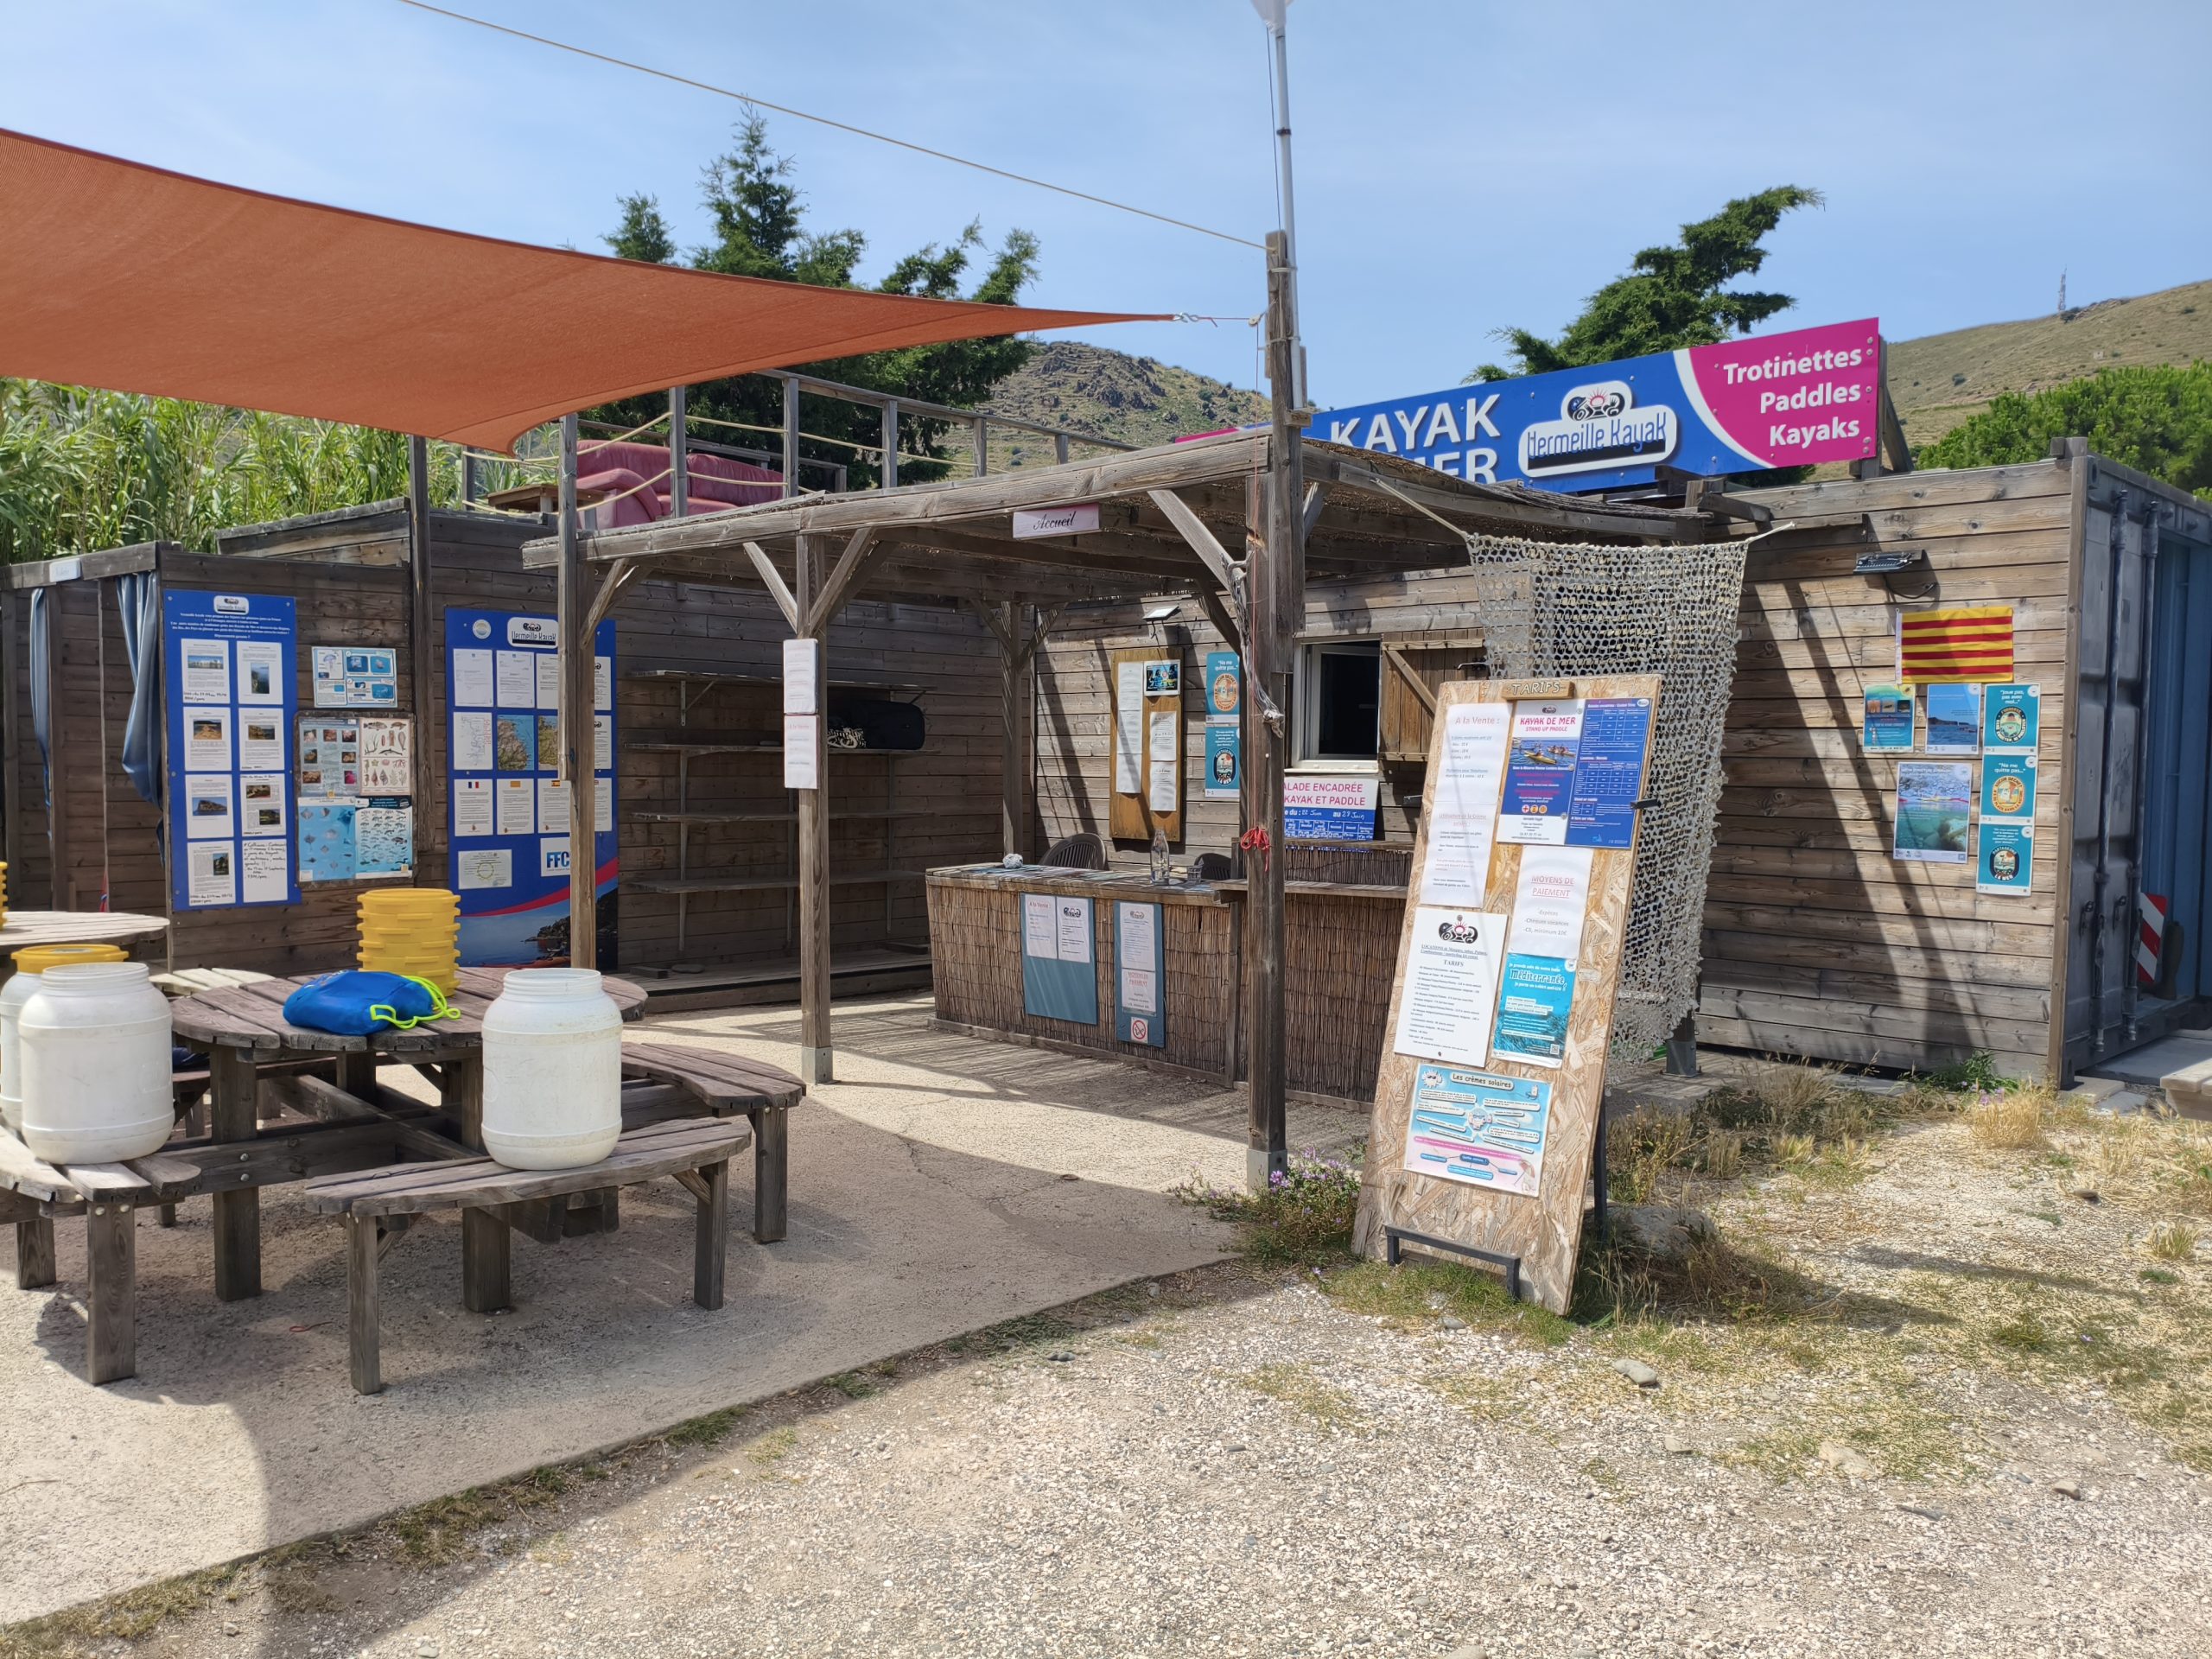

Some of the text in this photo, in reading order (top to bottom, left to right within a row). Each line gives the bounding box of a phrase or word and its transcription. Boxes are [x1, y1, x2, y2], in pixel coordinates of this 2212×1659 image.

[1723, 348, 1862, 385] Trotinettes
[1760, 382, 1861, 414] Paddles
[1331, 394, 1502, 453] KAYAK
[1770, 416, 1860, 448] Kayaks
[1033, 511, 1077, 531] Accueil
[1511, 681, 1560, 696] TARIFS
[1472, 716, 1495, 725] Vente
[1520, 717, 1544, 726] KAYAK
[1559, 716, 1576, 725] MER
[1284, 781, 1363, 793] ALADE ENCADRÉE
[1284, 795, 1366, 805] KAYAK ET PADDLE
[1531, 875, 1562, 885] MOYENS
[1532, 887, 1571, 897] PAIEMENT
[1465, 1075, 1486, 1084] crèmes
[1488, 1078, 1512, 1088] solaires
